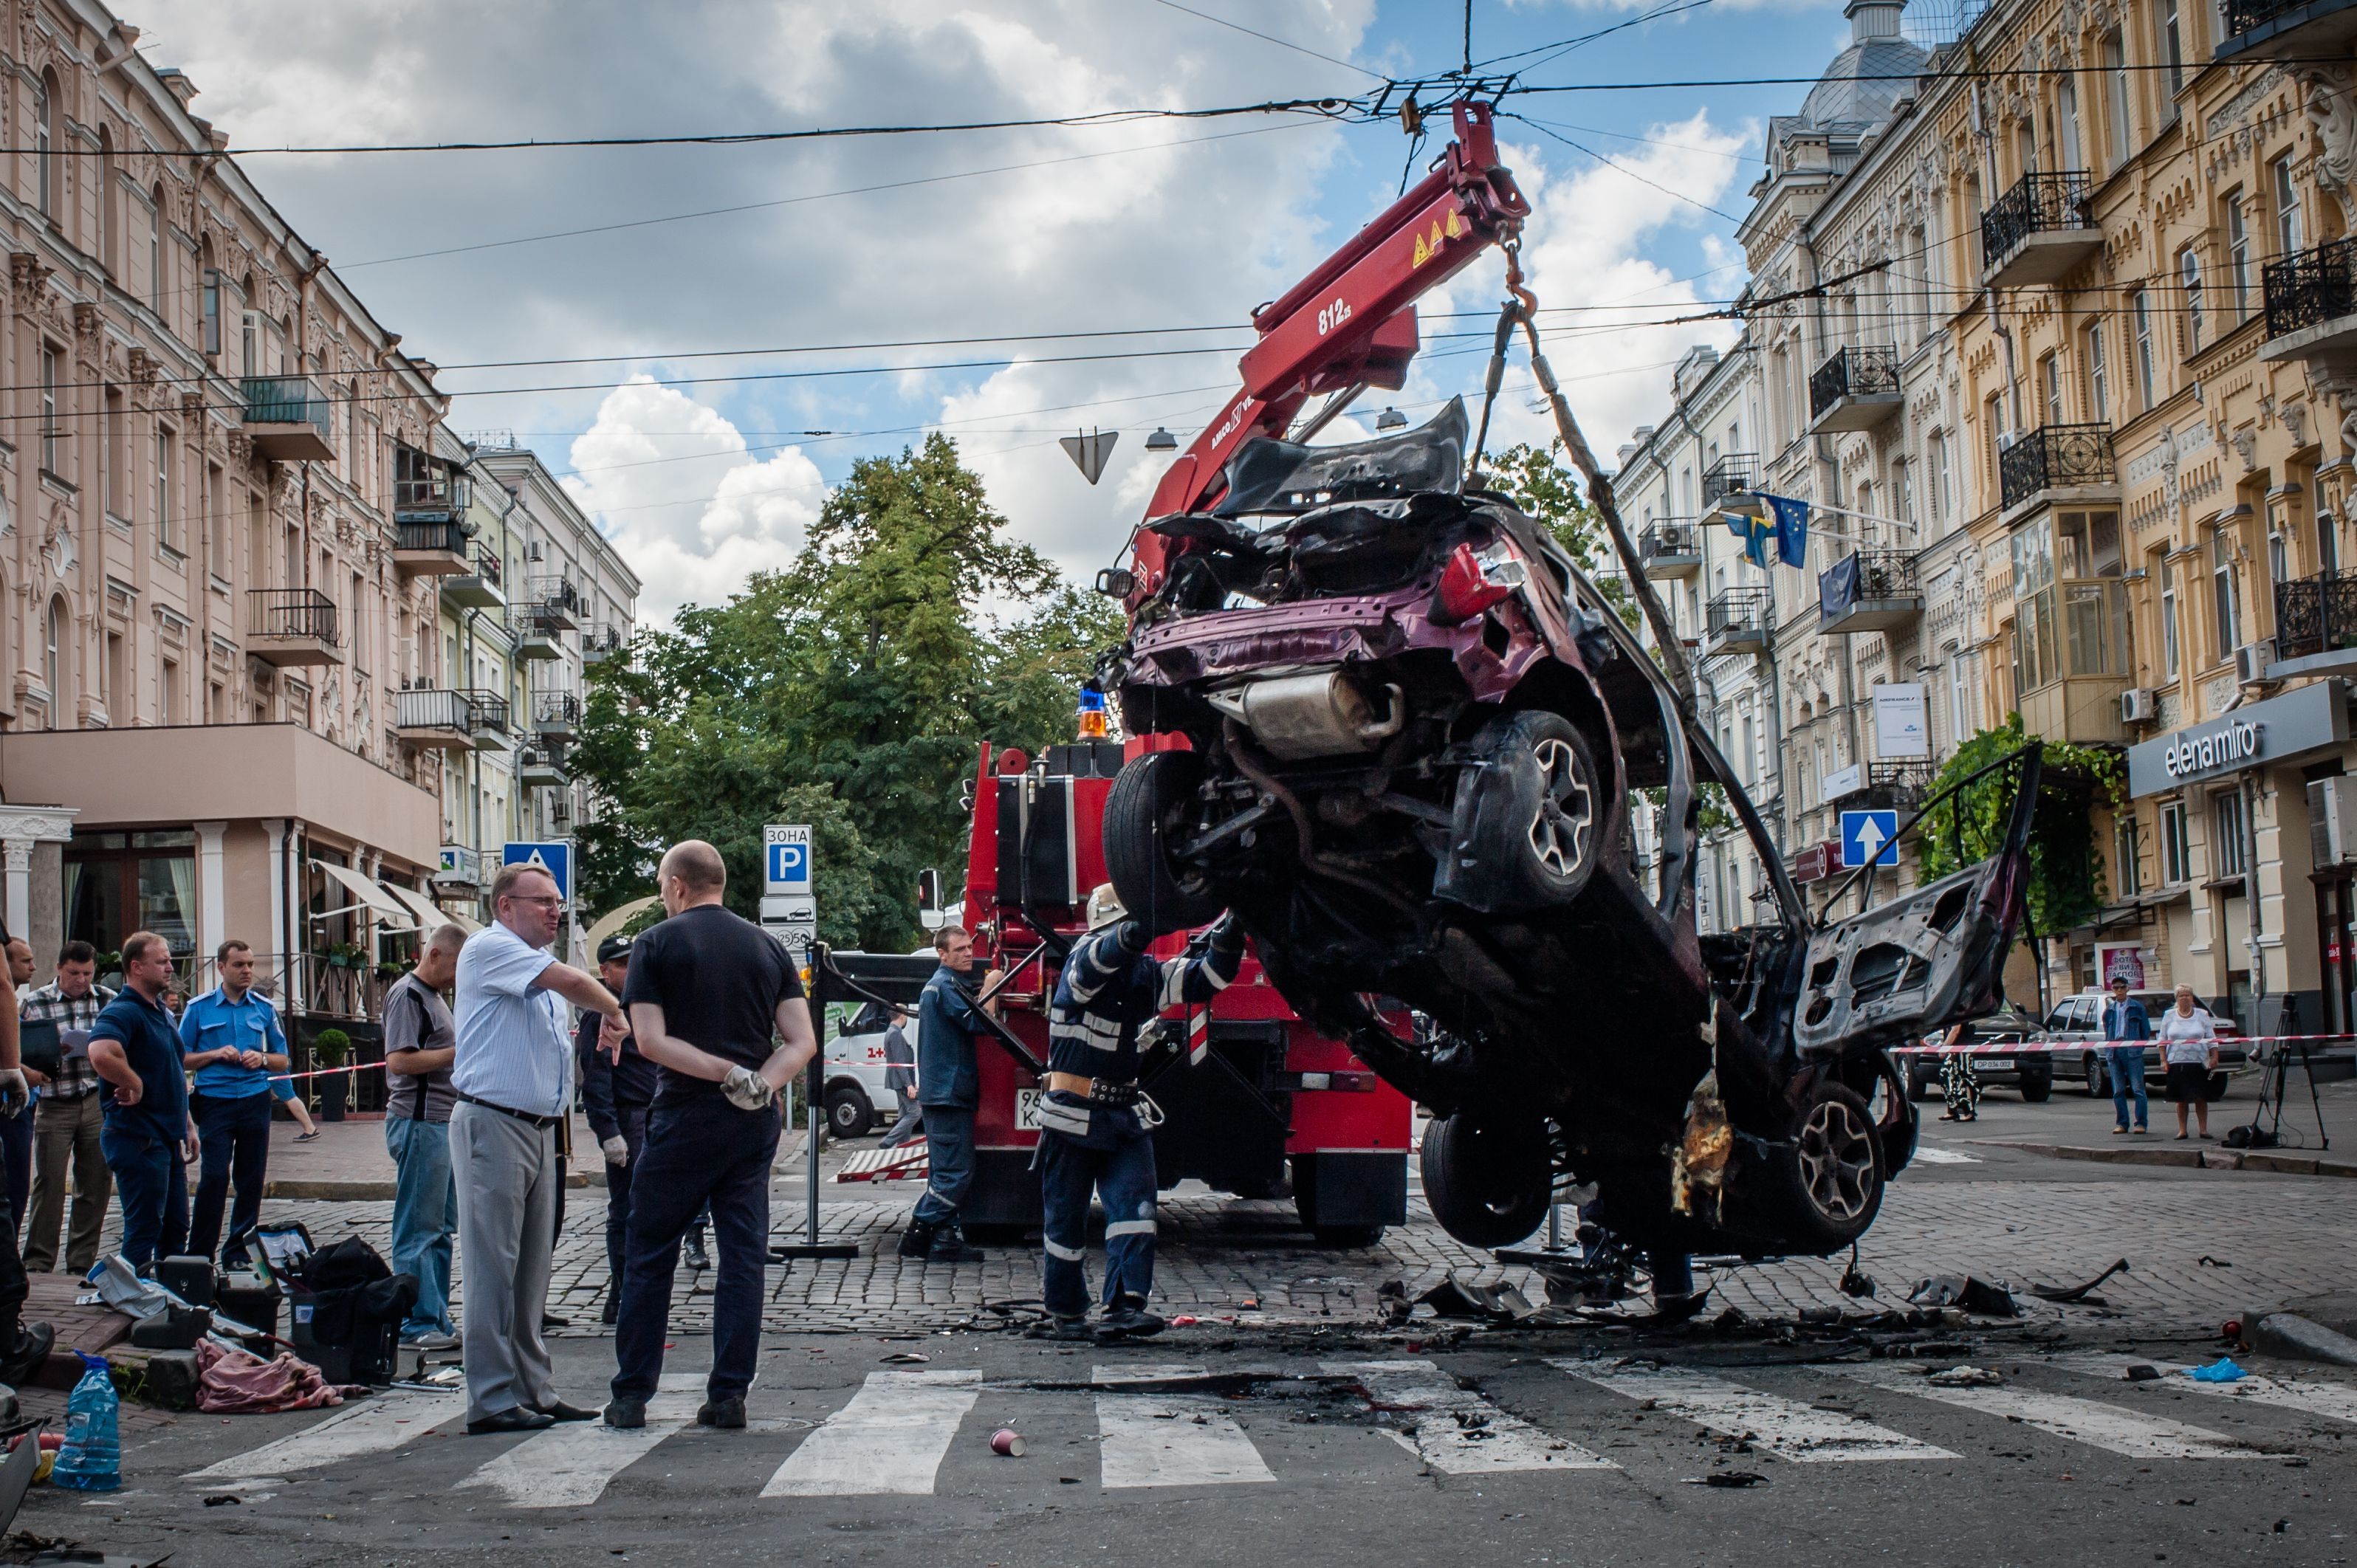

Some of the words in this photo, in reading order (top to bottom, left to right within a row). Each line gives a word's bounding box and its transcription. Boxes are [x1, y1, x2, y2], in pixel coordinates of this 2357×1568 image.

[1211, 422, 1231, 450] AMCO
[768, 830, 808, 842] ЗОНА
[779, 847, 801, 879] P
[779, 934, 790, 943] 25
[1022, 1091, 1041, 1108] 96
[1023, 1110, 1041, 1127] K
